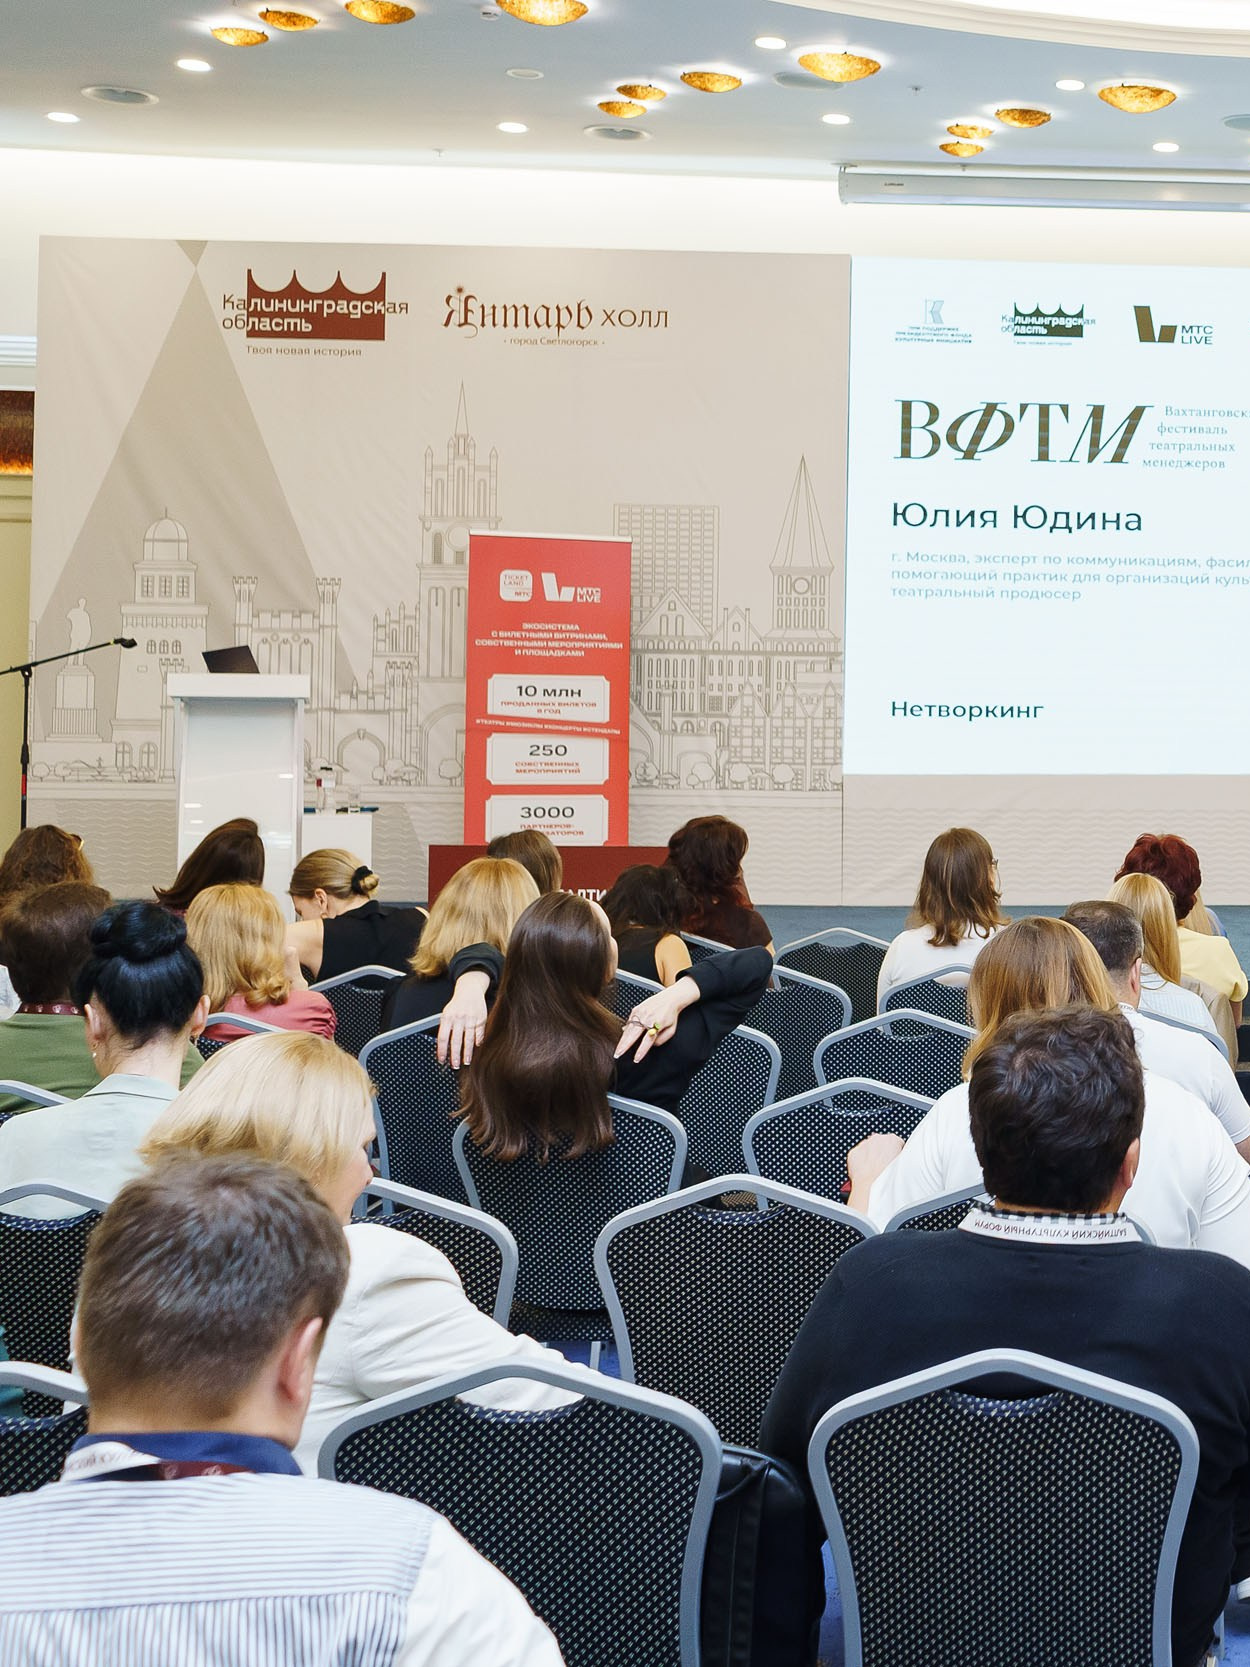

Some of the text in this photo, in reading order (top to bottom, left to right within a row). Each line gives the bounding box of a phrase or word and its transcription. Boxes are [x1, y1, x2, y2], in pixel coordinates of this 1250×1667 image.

[222, 293, 409, 319] Калининградская
[443, 286, 593, 338] Янтарь
[222, 314, 313, 333] область
[1001, 314, 1096, 328] Калининградская
[1000, 325, 1048, 335] область
[1180, 325, 1213, 335] МТС
[510, 337, 599, 347] город Светлогорск
[1180, 335, 1213, 345] LIVE
[246, 344, 362, 357] Твоя новая история
[893, 400, 1155, 464] ВФТМ
[1157, 421, 1228, 437] фестиваль
[1149, 442, 1236, 454] театральных
[1142, 459, 1226, 472] менеджеров
[892, 501, 1143, 534] Юлия Юдина
[891, 553, 901, 563] г.
[906, 551, 970, 566] Москва,
[974, 554, 1039, 567] эксперт
[1042, 555, 1063, 566] по
[1066, 555, 1202, 571] коммуникациям,
[891, 568, 998, 584] помогающий
[1002, 571, 1069, 585] практик
[1072, 572, 1101, 585] для
[1105, 572, 1210, 588] организаций
[891, 586, 1082, 603] театральный продюсер
[522, 622, 580, 631] ЭКОСИСТЕМА
[475, 639, 623, 650] СОБСТВЕННЫМИ МЕРОПРИЯТИЯМИ
[522, 649, 585, 658] ПЛОЩАДКАМИ
[516, 685, 537, 697] 10
[891, 700, 1044, 722] Нетворкинг
[529, 744, 568, 757] 250
[520, 806, 575, 819] 3000
[974, 1222, 1002, 1232] ФОРУМ
[1004, 1225, 1070, 1237] КУЛЬТУРНЫЙ
